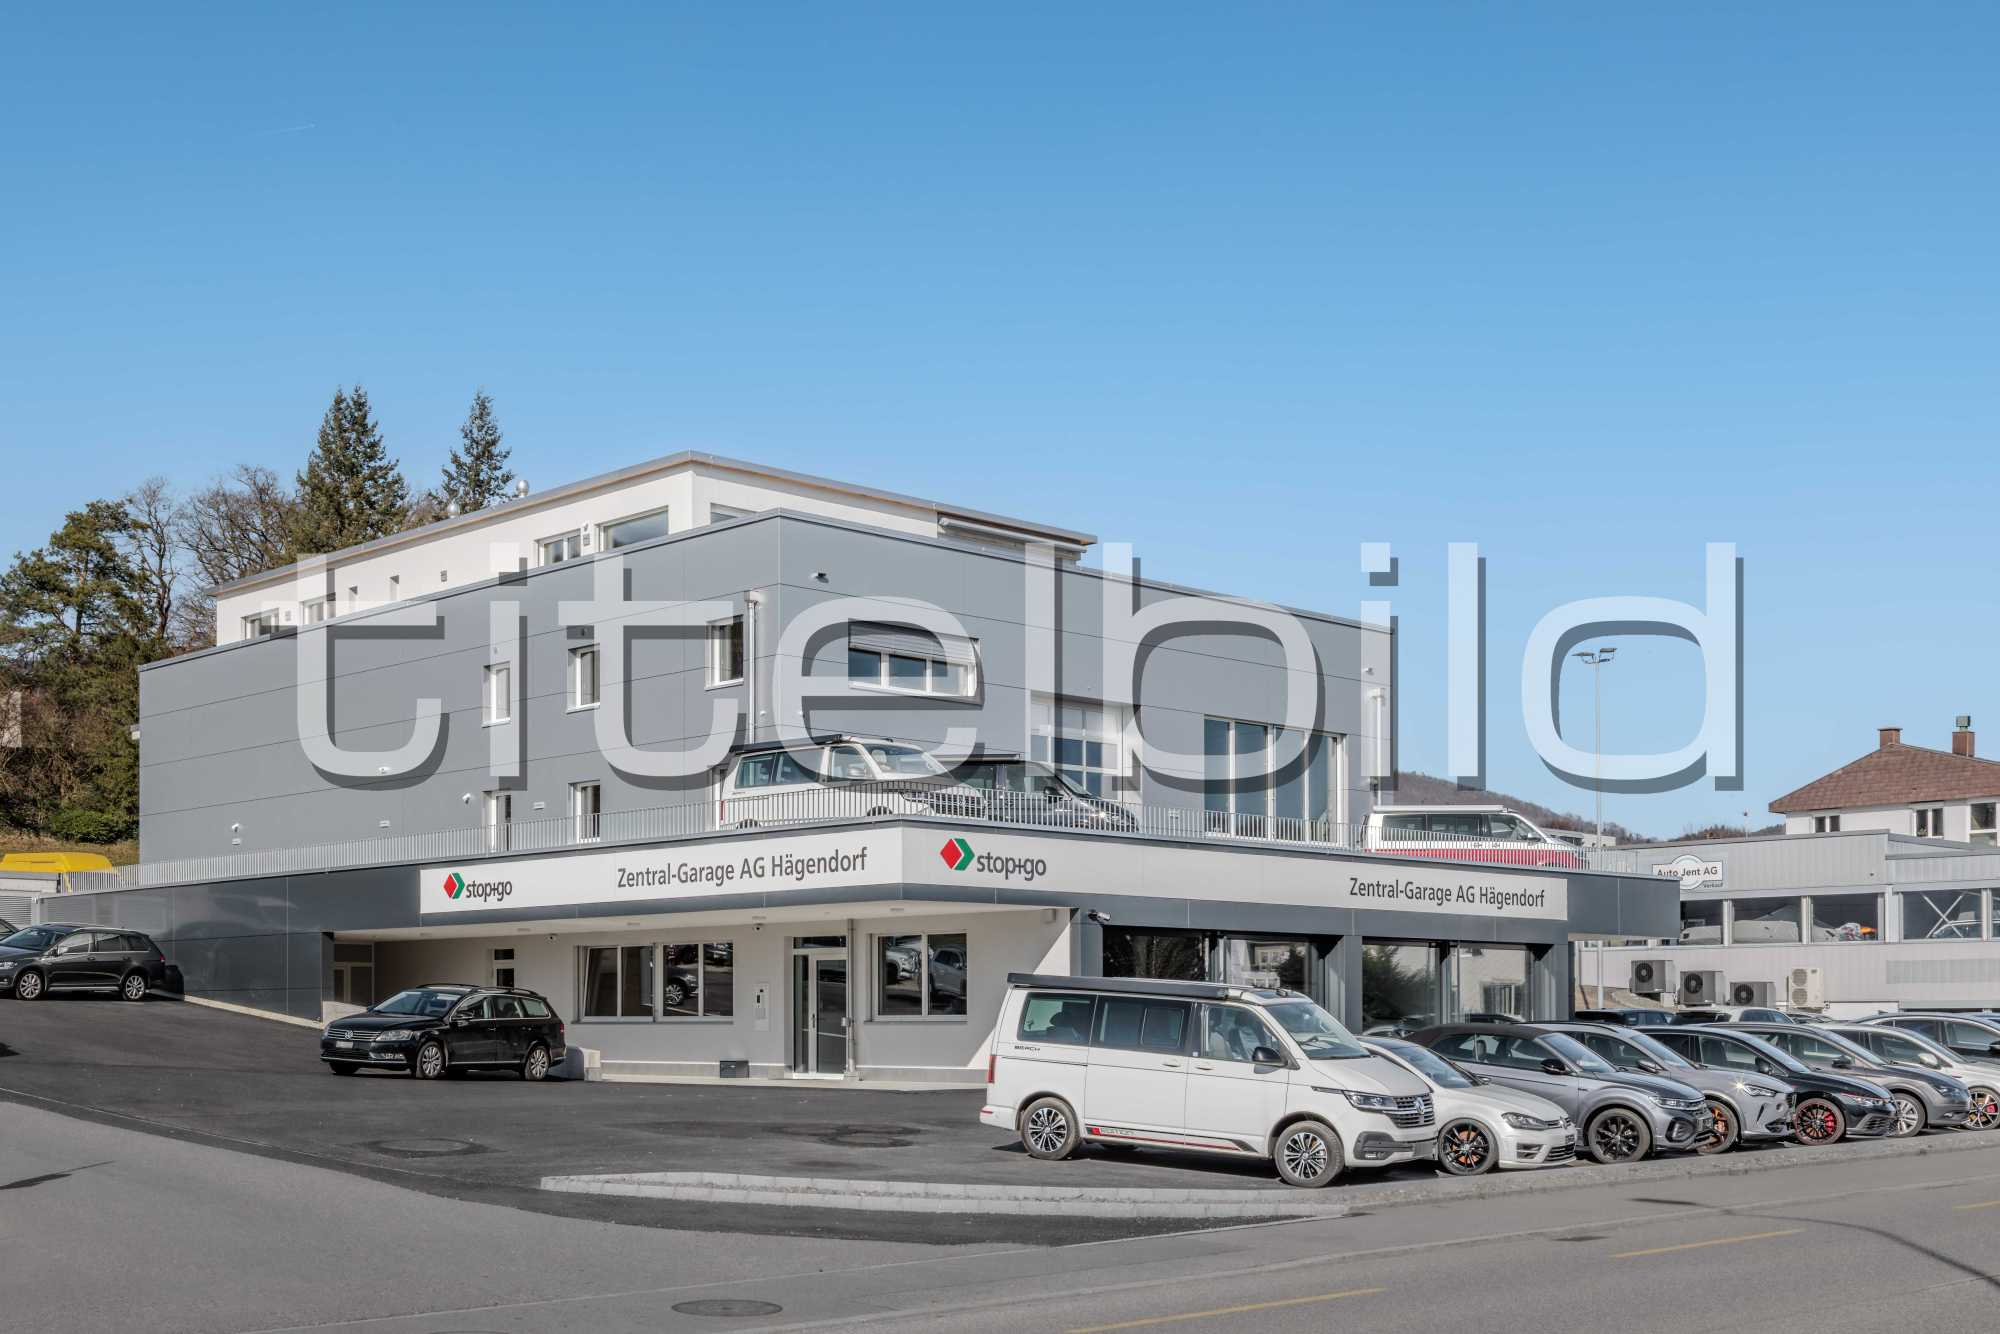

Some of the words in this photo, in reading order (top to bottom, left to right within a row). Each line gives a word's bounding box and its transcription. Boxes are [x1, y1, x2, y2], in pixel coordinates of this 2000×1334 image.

[617, 863, 735, 887] Zentral-Garage
[740, 857, 765, 879] AG
[771, 846, 868, 881] Hägendorf
[976, 852, 1047, 881] stop+go
[1657, 869, 1679, 878] Auto
[1681, 867, 1701, 877] Jent
[1703, 866, 1718, 875] AG
[466, 880, 513, 902] stop+go
[1350, 877, 1452, 906] Zentral-Garage
[1456, 885, 1475, 903] AG
[1479, 886, 1545, 910] Hägendorf
